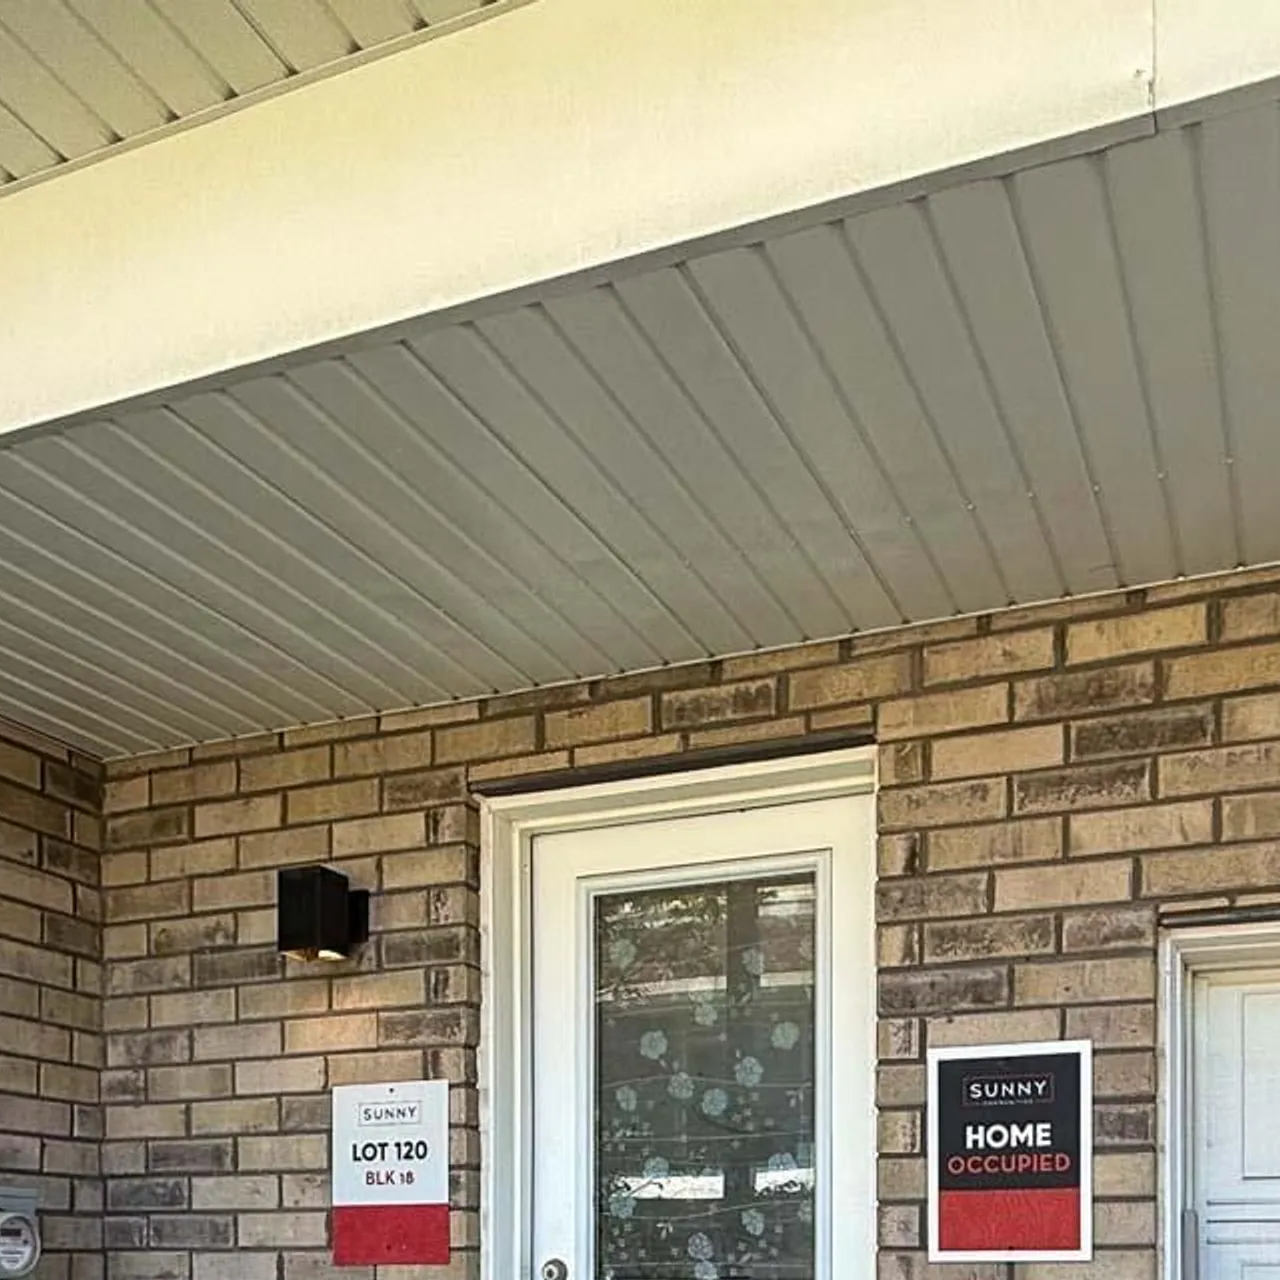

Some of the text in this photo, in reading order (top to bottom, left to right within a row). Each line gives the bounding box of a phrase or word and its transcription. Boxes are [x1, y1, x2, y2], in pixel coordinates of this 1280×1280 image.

[969, 1081, 1047, 1099] SUNNY
[363, 1106, 417, 1121] SUNNY
[965, 1122, 1052, 1150] HOME
[352, 1140, 428, 1162] LOT 120
[947, 1153, 1071, 1175] OCCUPIED
[365, 1170, 415, 1186] BLK 18
